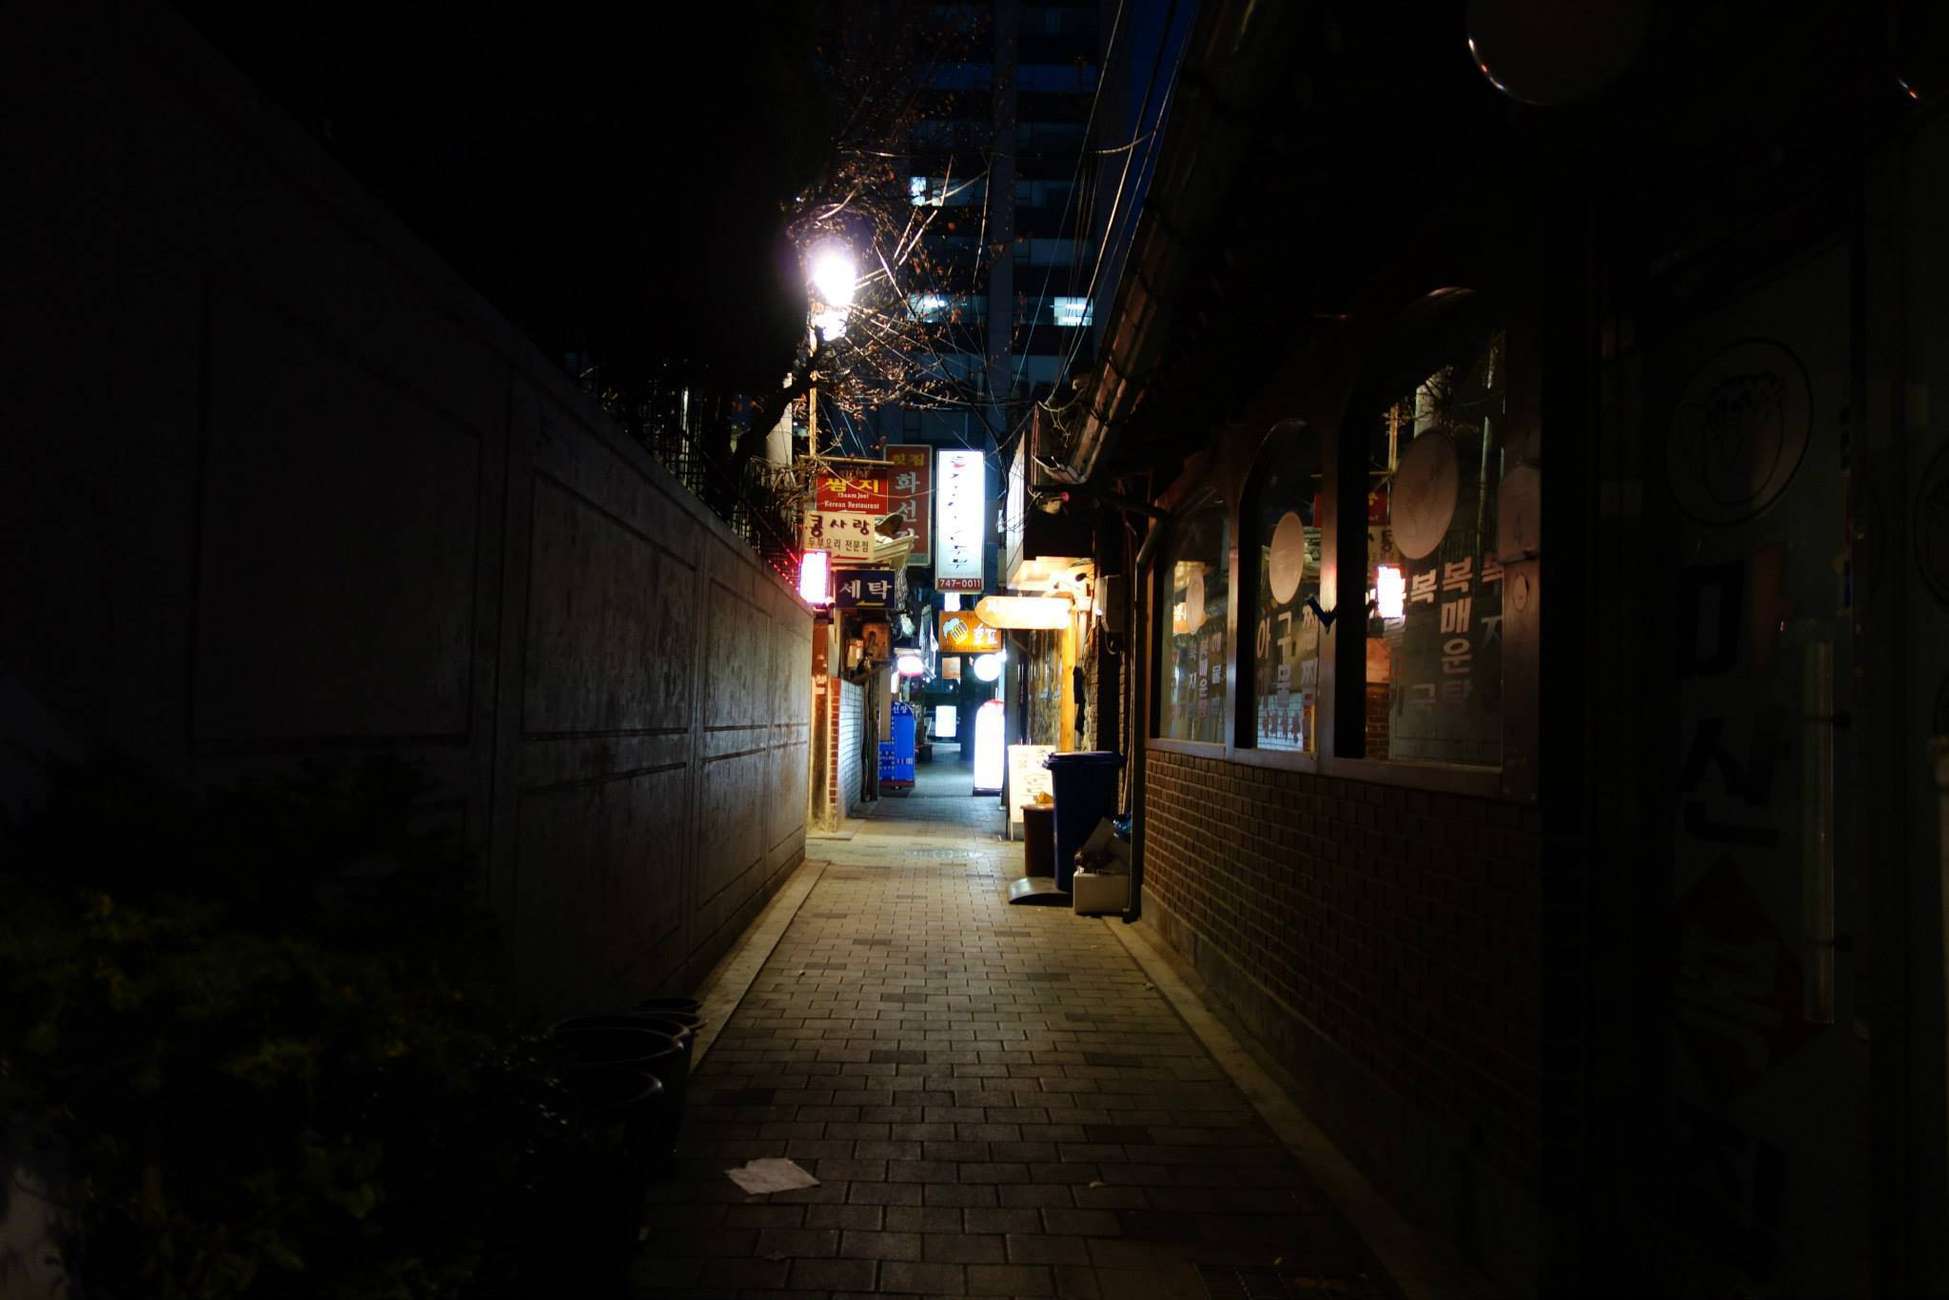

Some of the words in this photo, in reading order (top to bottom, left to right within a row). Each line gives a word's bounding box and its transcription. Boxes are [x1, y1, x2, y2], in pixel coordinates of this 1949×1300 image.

[824, 500, 846, 508] Korean
[847, 501, 880, 509] Restaurant
[809, 513, 871, 538] 콩사랑
[839, 579, 894, 601] 세탁
[939, 579, 982, 590] 747-0011
